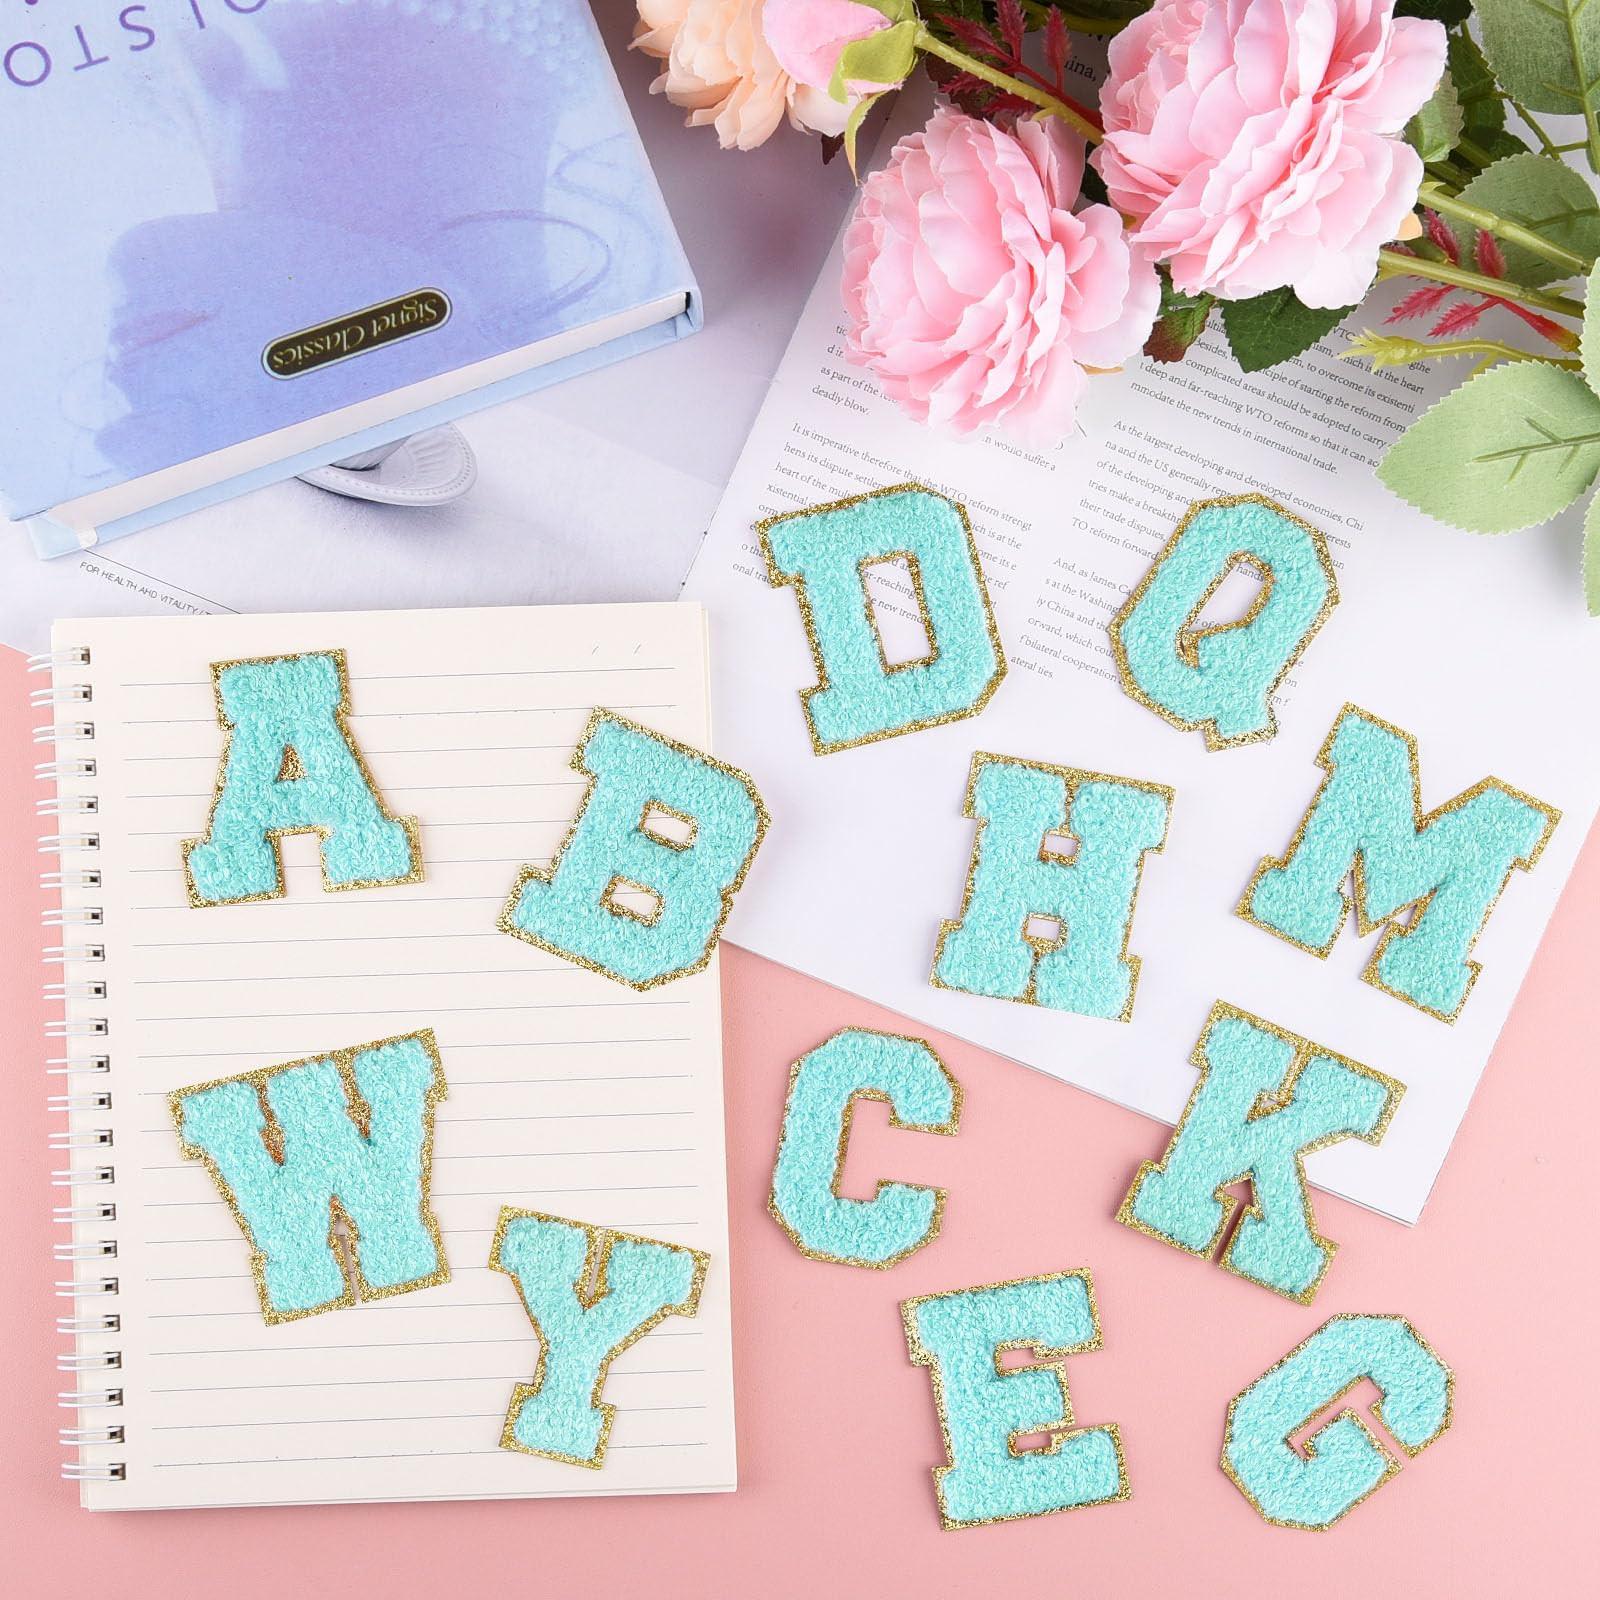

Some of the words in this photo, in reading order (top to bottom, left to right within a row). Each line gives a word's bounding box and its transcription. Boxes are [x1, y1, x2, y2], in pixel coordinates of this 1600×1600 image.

[274, 323, 362, 369] Classics
[367, 296, 437, 338] Signet
[826, 343, 836, 354] d
[811, 383, 844, 406] deadly
[819, 366, 831, 376] as
[829, 370, 852, 385] part
[851, 379, 866, 389] of
[862, 382, 879, 396] the
[1049, 462, 1057, 473] a
[1144, 362, 1168, 381] deep
[1167, 374, 1188, 388] and
[1186, 380, 1244, 414] far-reaching
[1245, 403, 1273, 423] WTO
[1272, 418, 1309, 439] reforms
[1308, 434, 1321, 444] so
[1321, 436, 1341, 452] that
[1340, 444, 1349, 456] it
[1348, 450, 1366, 463] can
[1184, 358, 1243, 388] complicated
[1241, 382, 1267, 397] areas
[1265, 391, 1300, 411] should
[1298, 402, 1312, 417] be
[1311, 411, 1352, 433] adopted
[1350, 427, 1362, 438] to
[1361, 432, 1388, 449] carry
[1287, 378, 1302, 389] of
[1298, 383, 1334, 405] starting
[1333, 395, 1350, 410] the
[1349, 404, 1382, 424] reform
[1381, 415, 1406, 434] from
[1306, 362, 1317, 373] to
[1317, 368, 1365, 393] overcome
[1363, 384, 1377, 398] its
[1375, 392, 1416, 414] existenti
[1383, 370, 1400, 384] the
[1399, 375, 1425, 395] heart
[1104, 440, 1117, 451] na
[1117, 446, 1138, 459] and
[1136, 452, 1153, 466] the
[1153, 458, 1170, 473] US
[1167, 468, 1212, 492] generally
[1129, 381, 1176, 406] mmodate
[1175, 398, 1192, 413] the
[1191, 407, 1213, 421] new
[1212, 415, 1242, 434] trends
[1241, 426, 1252, 439] in
[1252, 433, 1313, 464] international
[1312, 456, 1338, 474] trade.
[774, 460, 800, 480] heart
[799, 474, 814, 484] of
[811, 476, 828, 491] the
[997, 554, 1011, 568] its
[1009, 563, 1017, 571] e
[782, 440, 806, 459] hens
[806, 450, 819, 464] its
[818, 456, 854, 478] dispute
[986, 526, 997, 539] is
[995, 533, 1007, 543] at
[1006, 536, 1023, 550] the
[791, 422, 801, 433] It
[800, 427, 811, 437] is
[809, 429, 860, 458] imperative
[860, 450, 903, 475] therefore
[903, 469, 921, 485] that
[922, 477, 938, 492] the
[939, 483, 968, 503] WTO
[967, 498, 1000, 517] reform
[1000, 512, 1032, 531] strengt
[1087, 478, 1108, 493] tries
[1107, 488, 1135, 505] make
[1133, 499, 1141, 508] a
[1095, 460, 1110, 470] of
[1107, 462, 1124, 477] the
[1122, 470, 1175, 501] developing
[1174, 493, 1195, 508] and
[1112, 419, 1127, 432] As
[1127, 425, 1143, 438] the
[1142, 430, 1174, 452] largest
[1173, 444, 1225, 474] developing
[1223, 468, 1245, 481] and
[1243, 474, 1293, 501] developed
[1291, 496, 1344, 524] economies,
[1344, 516, 1365, 532] Chi
[79, 561, 100, 576] FOR
[101, 569, 138, 590] HEALTH
[731, 562, 755, 577] onal
[740, 542, 749, 551] o
[876, 599, 898, 613] new
[765, 483, 809, 506] xistential
[992, 579, 1010, 590] ref
[1052, 556, 1076, 575] And,
[1077, 568, 1089, 578] as
[1088, 570, 1117, 590] James
[1071, 516, 1089, 531] TO
[1088, 526, 1121, 545] reform
[1121, 538, 1160, 562] forward
[1078, 497, 1102, 513] their
[1101, 508, 1126, 524] trade
[1126, 517, 1168, 543] disputes,
[1235, 561, 1265, 583] hands
[755, 482, 1008, 757] D
[1044, 577, 1051, 585] s
[1050, 580, 1061, 590] at
[1060, 582, 1077, 596] the
[1046, 599, 1075, 619] China
[1075, 613, 1096, 627] and
[1108, 494, 1340, 752] Q
[1009, 655, 1038, 672] ateral
[1024, 635, 1062, 659] bilateral
[1061, 654, 1119, 683] cooperation
[1026, 616, 1063, 638] orward,
[1065, 631, 1093, 649] which
[181, 648, 425, 908] A
[496, 706, 773, 991] B
[928, 750, 1177, 1022] H
[1233, 701, 1562, 1025] M
[167, 1027, 450, 1326] W
[767, 1026, 964, 1270] C
[1113, 1000, 1407, 1305] K
[488, 1205, 711, 1470] Y
[899, 1266, 1132, 1531] E
[1220, 1313, 1456, 1531] G
